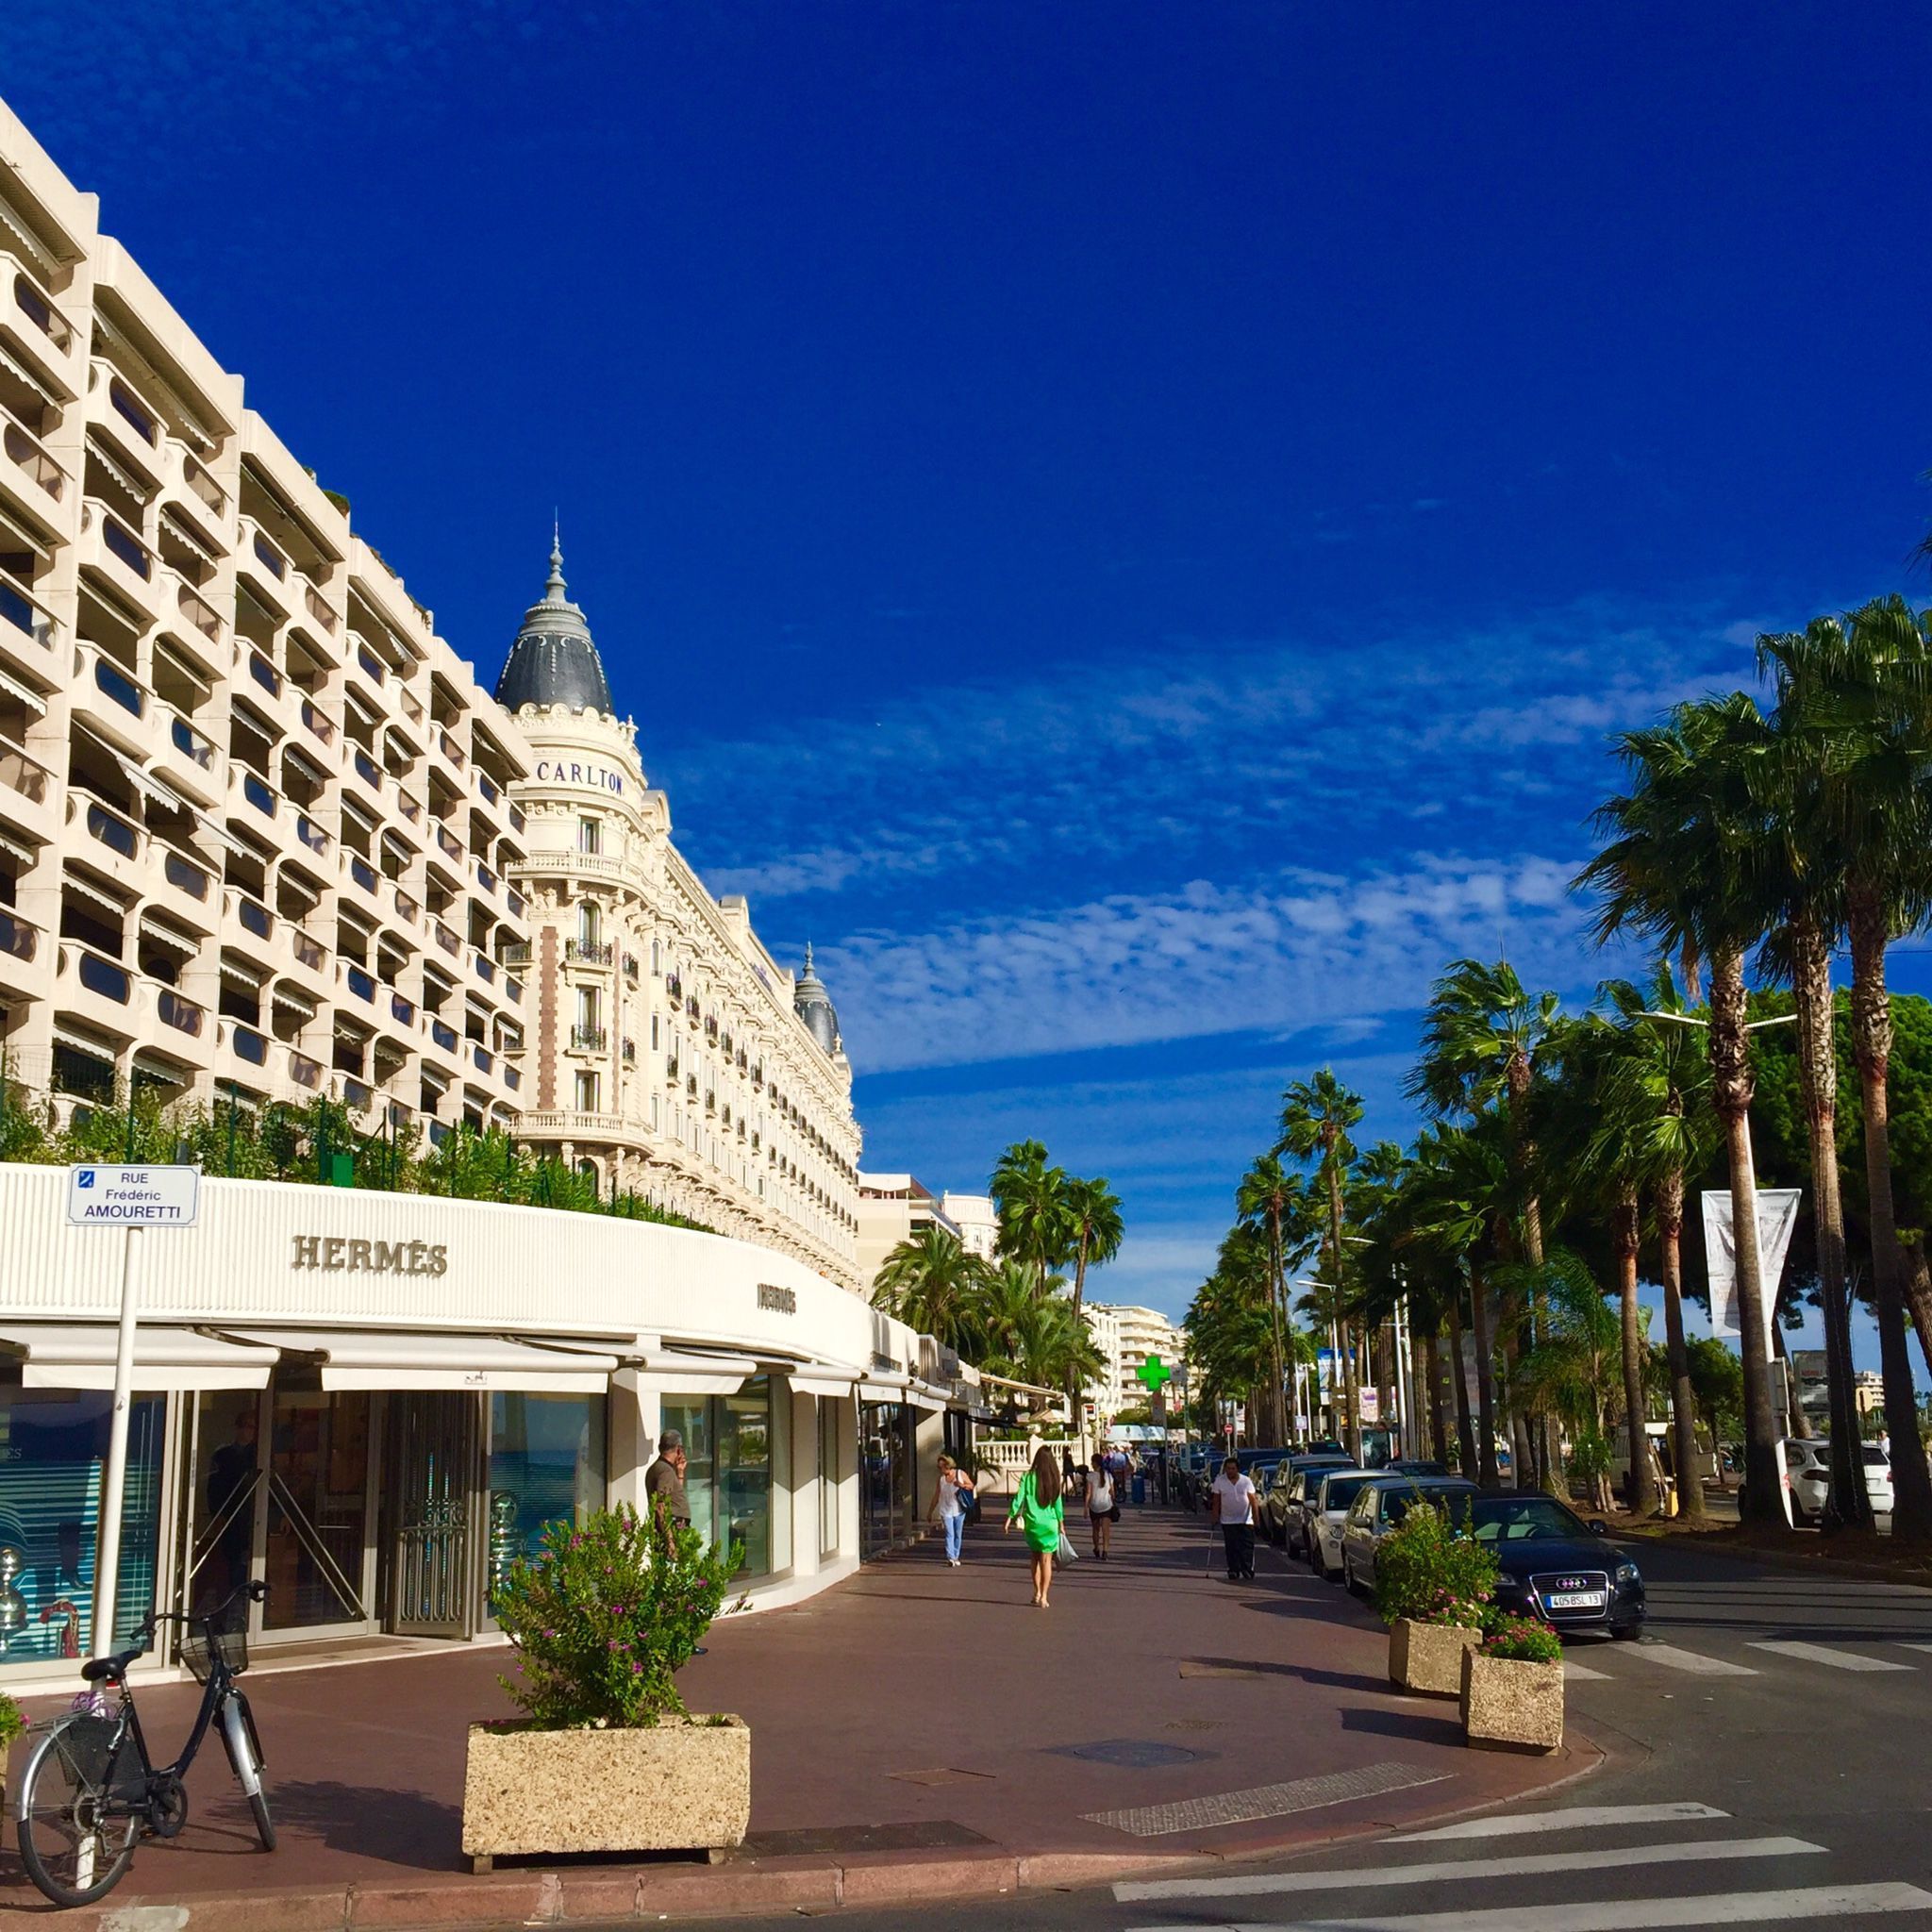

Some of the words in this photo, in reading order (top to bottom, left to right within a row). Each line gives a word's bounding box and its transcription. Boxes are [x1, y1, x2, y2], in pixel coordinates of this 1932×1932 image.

[536, 761, 624, 796] CARLTON
[121, 1172, 149, 1184] RUE
[105, 1189, 161, 1201] Frédéric
[84, 1205, 181, 1219] AMOURETTI
